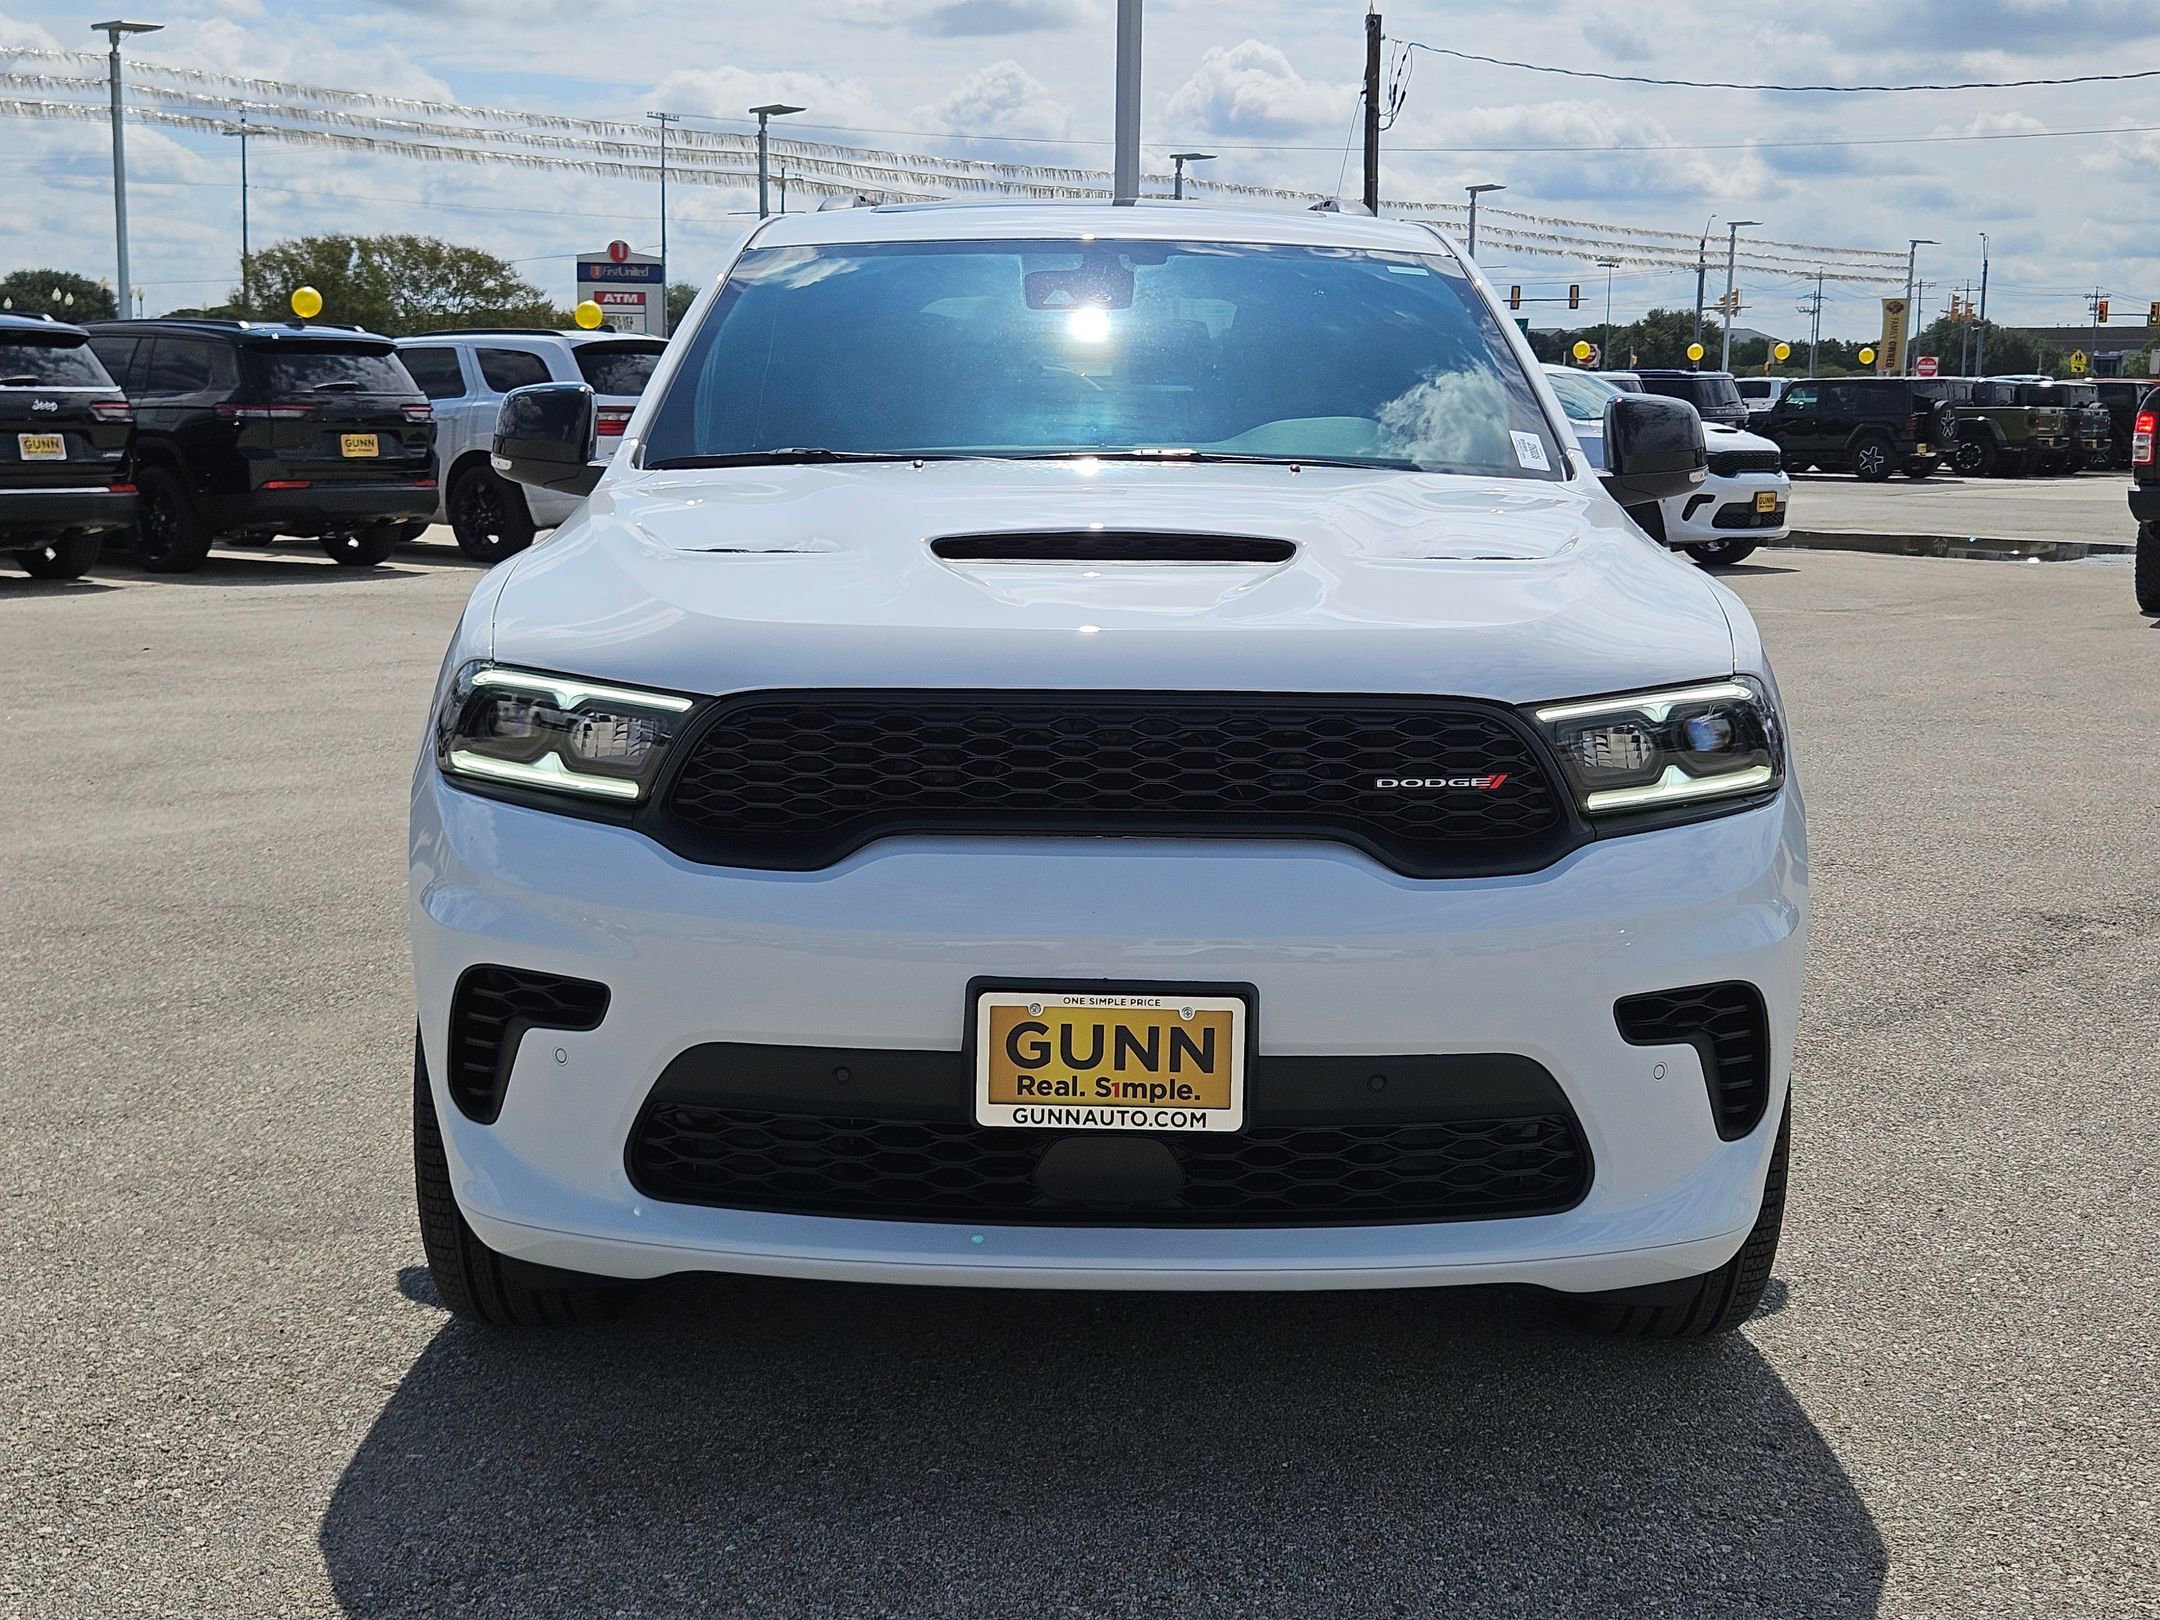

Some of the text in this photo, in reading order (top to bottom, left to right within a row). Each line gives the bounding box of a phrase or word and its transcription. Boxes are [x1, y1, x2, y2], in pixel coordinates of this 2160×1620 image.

[603, 293, 638, 304] ATM
[1885, 341, 1897, 368] OWNED
[32, 399, 58, 412] Jeep
[24, 439, 60, 450] GUNN
[345, 439, 375, 448] GUNN
[1376, 777, 1492, 788] DODGE
[1063, 996, 1161, 1007] ONE SIMPLE PRICE
[1005, 1021, 1216, 1074] GUNN
[1017, 1075, 1086, 1097] Real.
[1012, 1107, 1207, 1128] GUNNAUTO.COM
